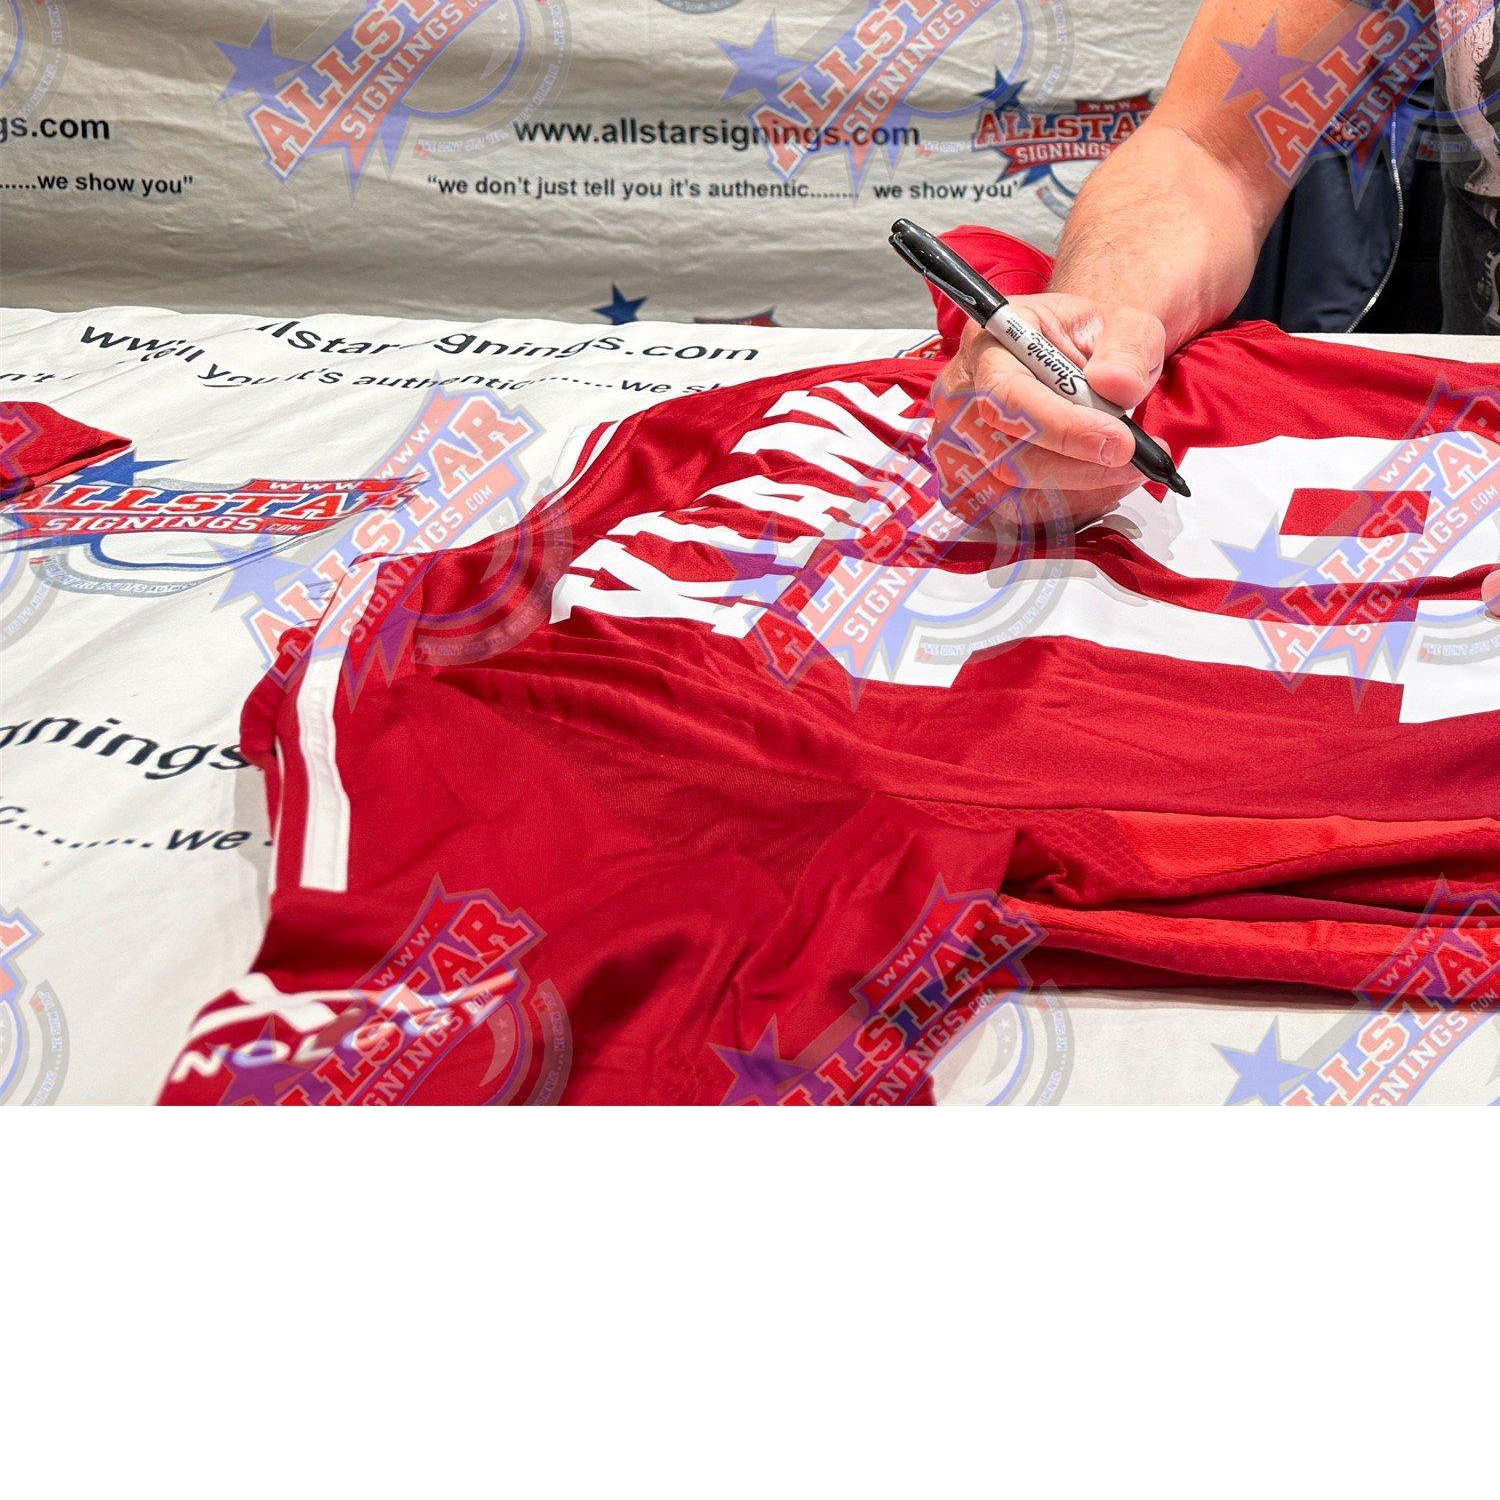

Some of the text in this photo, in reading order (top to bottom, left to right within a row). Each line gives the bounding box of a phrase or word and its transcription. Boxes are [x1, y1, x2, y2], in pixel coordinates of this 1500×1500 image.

[514, 118, 920, 157] www.allstarsignings.com
[535, 176, 577, 200] just
[584, 178, 615, 196] tell
[622, 182, 662, 201] you
[873, 185, 903, 199] we
[909, 181, 967, 199] show
[47, 514, 268, 534] SIGNINGS
